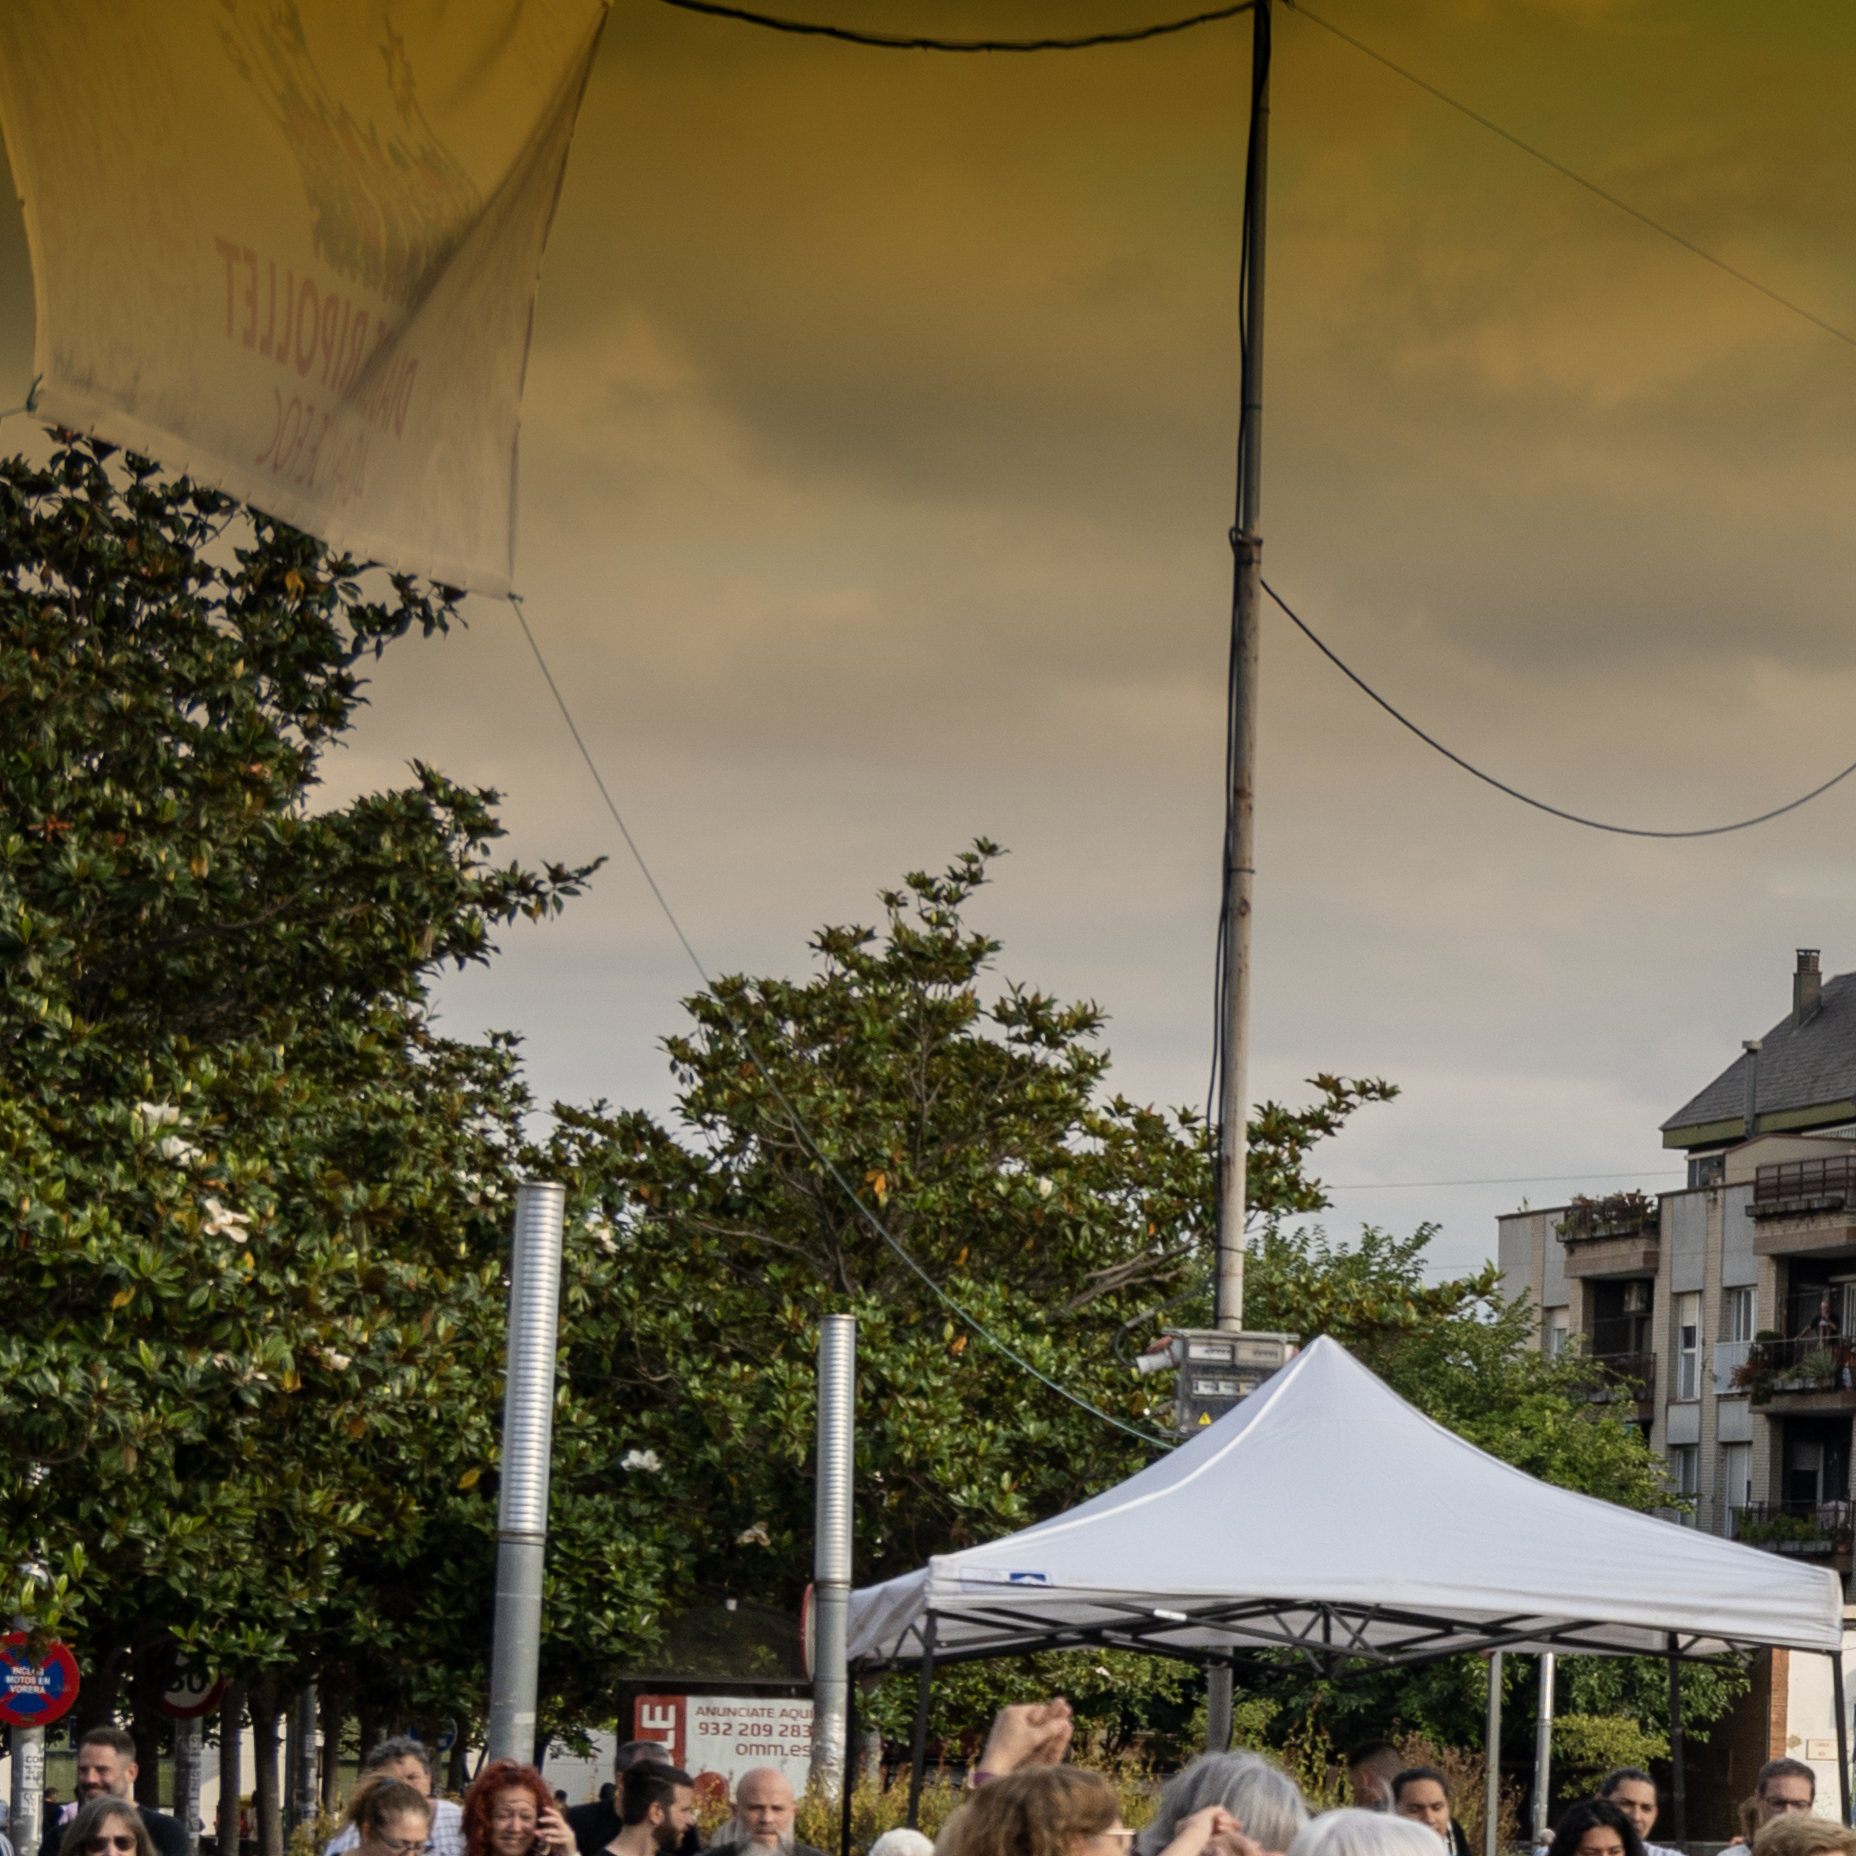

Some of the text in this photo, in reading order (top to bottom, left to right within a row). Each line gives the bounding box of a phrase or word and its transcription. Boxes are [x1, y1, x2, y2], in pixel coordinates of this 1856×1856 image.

[695, 1706, 775, 1719] ANUNCIATE
[698, 1721, 812, 1738] 932 209 283
[735, 1742, 811, 1758] omm.es
